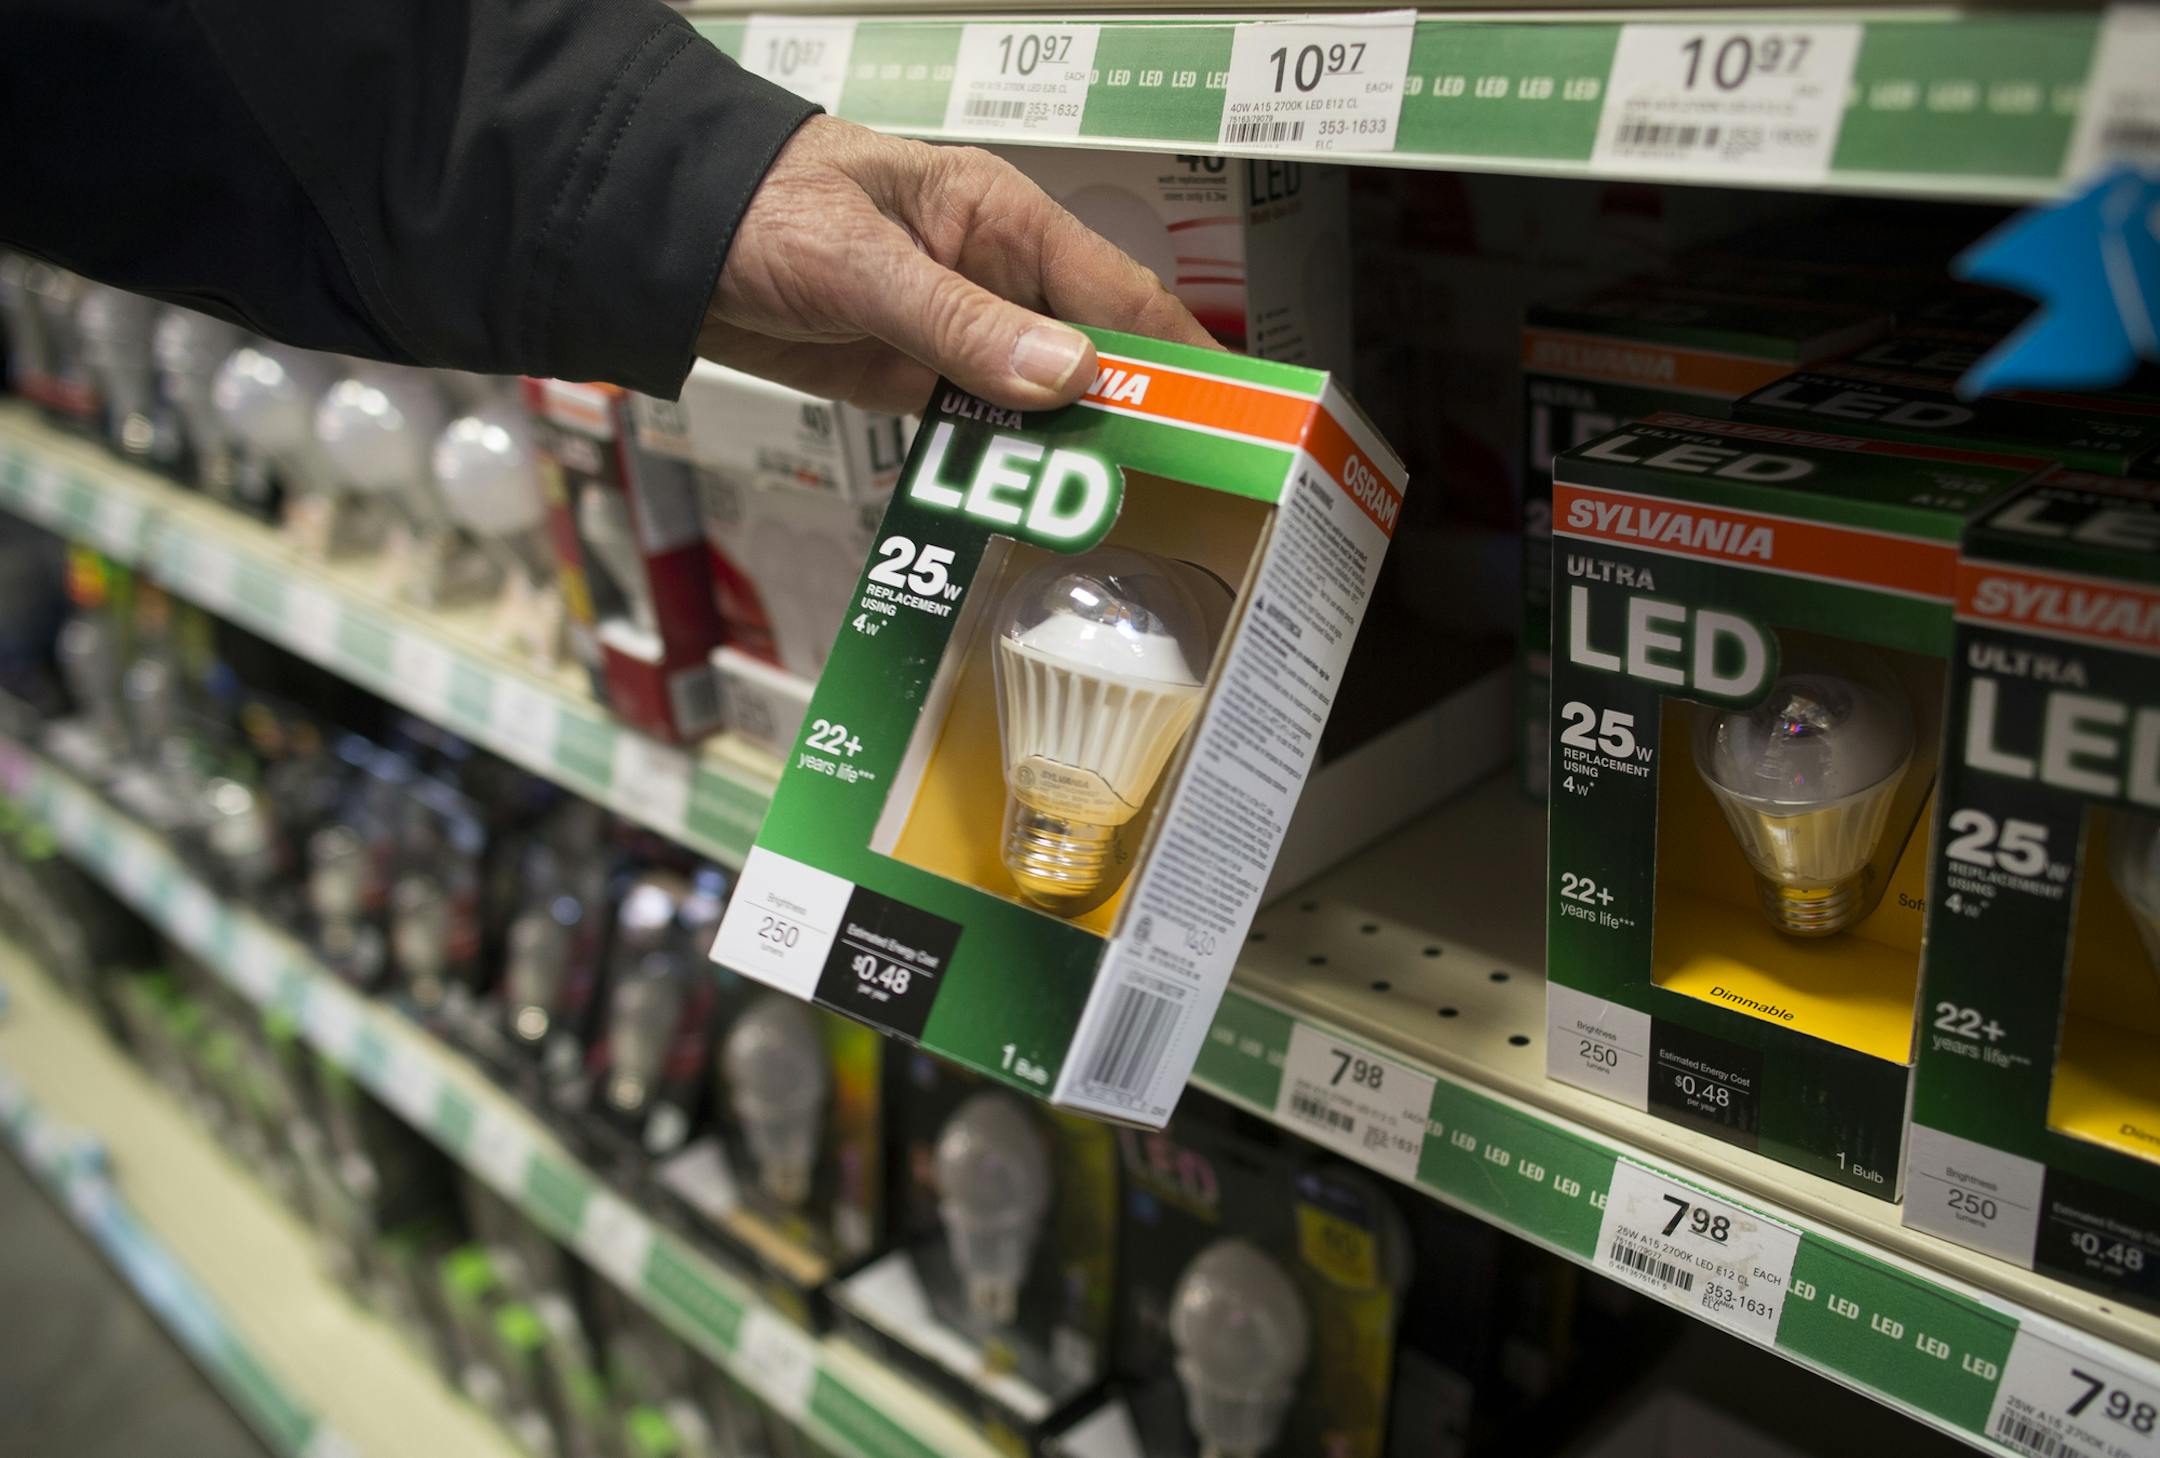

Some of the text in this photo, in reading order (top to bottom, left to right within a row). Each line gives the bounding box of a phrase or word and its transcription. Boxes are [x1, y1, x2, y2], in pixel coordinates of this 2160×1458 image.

[1107, 69, 1131, 86] LED
[1139, 70, 1164, 88] LED
[1172, 70, 1197, 88] LED
[1365, 83, 1393, 94] EACH
[1433, 76, 1466, 97] LED
[1475, 76, 1509, 98] LED
[1027, 101, 1080, 118] 353-1632
[1230, 98, 1359, 113] 40W A15 2700K LED E12 CL
[1318, 118, 1387, 136] 353-1633
[940, 390, 1024, 431] ULTRA
[1748, 381, 1976, 429] LED
[1632, 427, 1723, 446] ULTRA
[1578, 433, 1818, 484] LED
[910, 421, 1112, 540] LED
[1343, 454, 1399, 530] OSRAM
[1567, 498, 1775, 560] SYLVANIA
[1567, 553, 1657, 591] ULTRA
[860, 597, 897, 617] USING
[865, 583, 953, 618] REPLACEMENT
[1569, 584, 1767, 698] LED
[1967, 642, 2088, 688] ULTRA
[805, 718, 864, 757] 22+
[796, 752, 837, 776] years
[1563, 747, 1651, 778] REPLACEMENT
[1563, 760, 1599, 778] USING
[1560, 871, 1615, 906] 22+
[1947, 875, 1997, 898] USING
[1948, 861, 2065, 900] REPLACEMENT
[1560, 901, 1597, 923] years
[758, 915, 800, 948] 250
[851, 954, 912, 995] $0.48
[1709, 985, 1796, 1022] Dimmable
[1576, 1020, 1617, 1042] Brightness
[1933, 1001, 2006, 1044] 22+
[1002, 1043, 1017, 1070] 1
[1579, 1040, 1618, 1067] 250
[1933, 1032, 1980, 1061] years
[1659, 1048, 1751, 1088] Estimated Energy Cost
[1675, 1074, 1730, 1107] $0.48
[1451, 1129, 1477, 1152] LED
[1484, 1144, 1511, 1168] LED
[1518, 1159, 1546, 1183] LED
[1553, 1174, 1581, 1198] LED
[1836, 1151, 1884, 1184] 1 Bulb
[1947, 1188, 1997, 1221] 250
[1616, 1224, 1749, 1287] 25W A15 2700K LED E12 CL
[2071, 1231, 2145, 1271] $0.48
[1753, 1267, 1782, 1286] EACH
[1705, 1281, 1774, 1320] 353-1631
[1827, 1294, 1859, 1320] LED
[1871, 1313, 1904, 1340] LED
[1915, 1333, 1950, 1360] LED
[1962, 1353, 1998, 1381] LED
